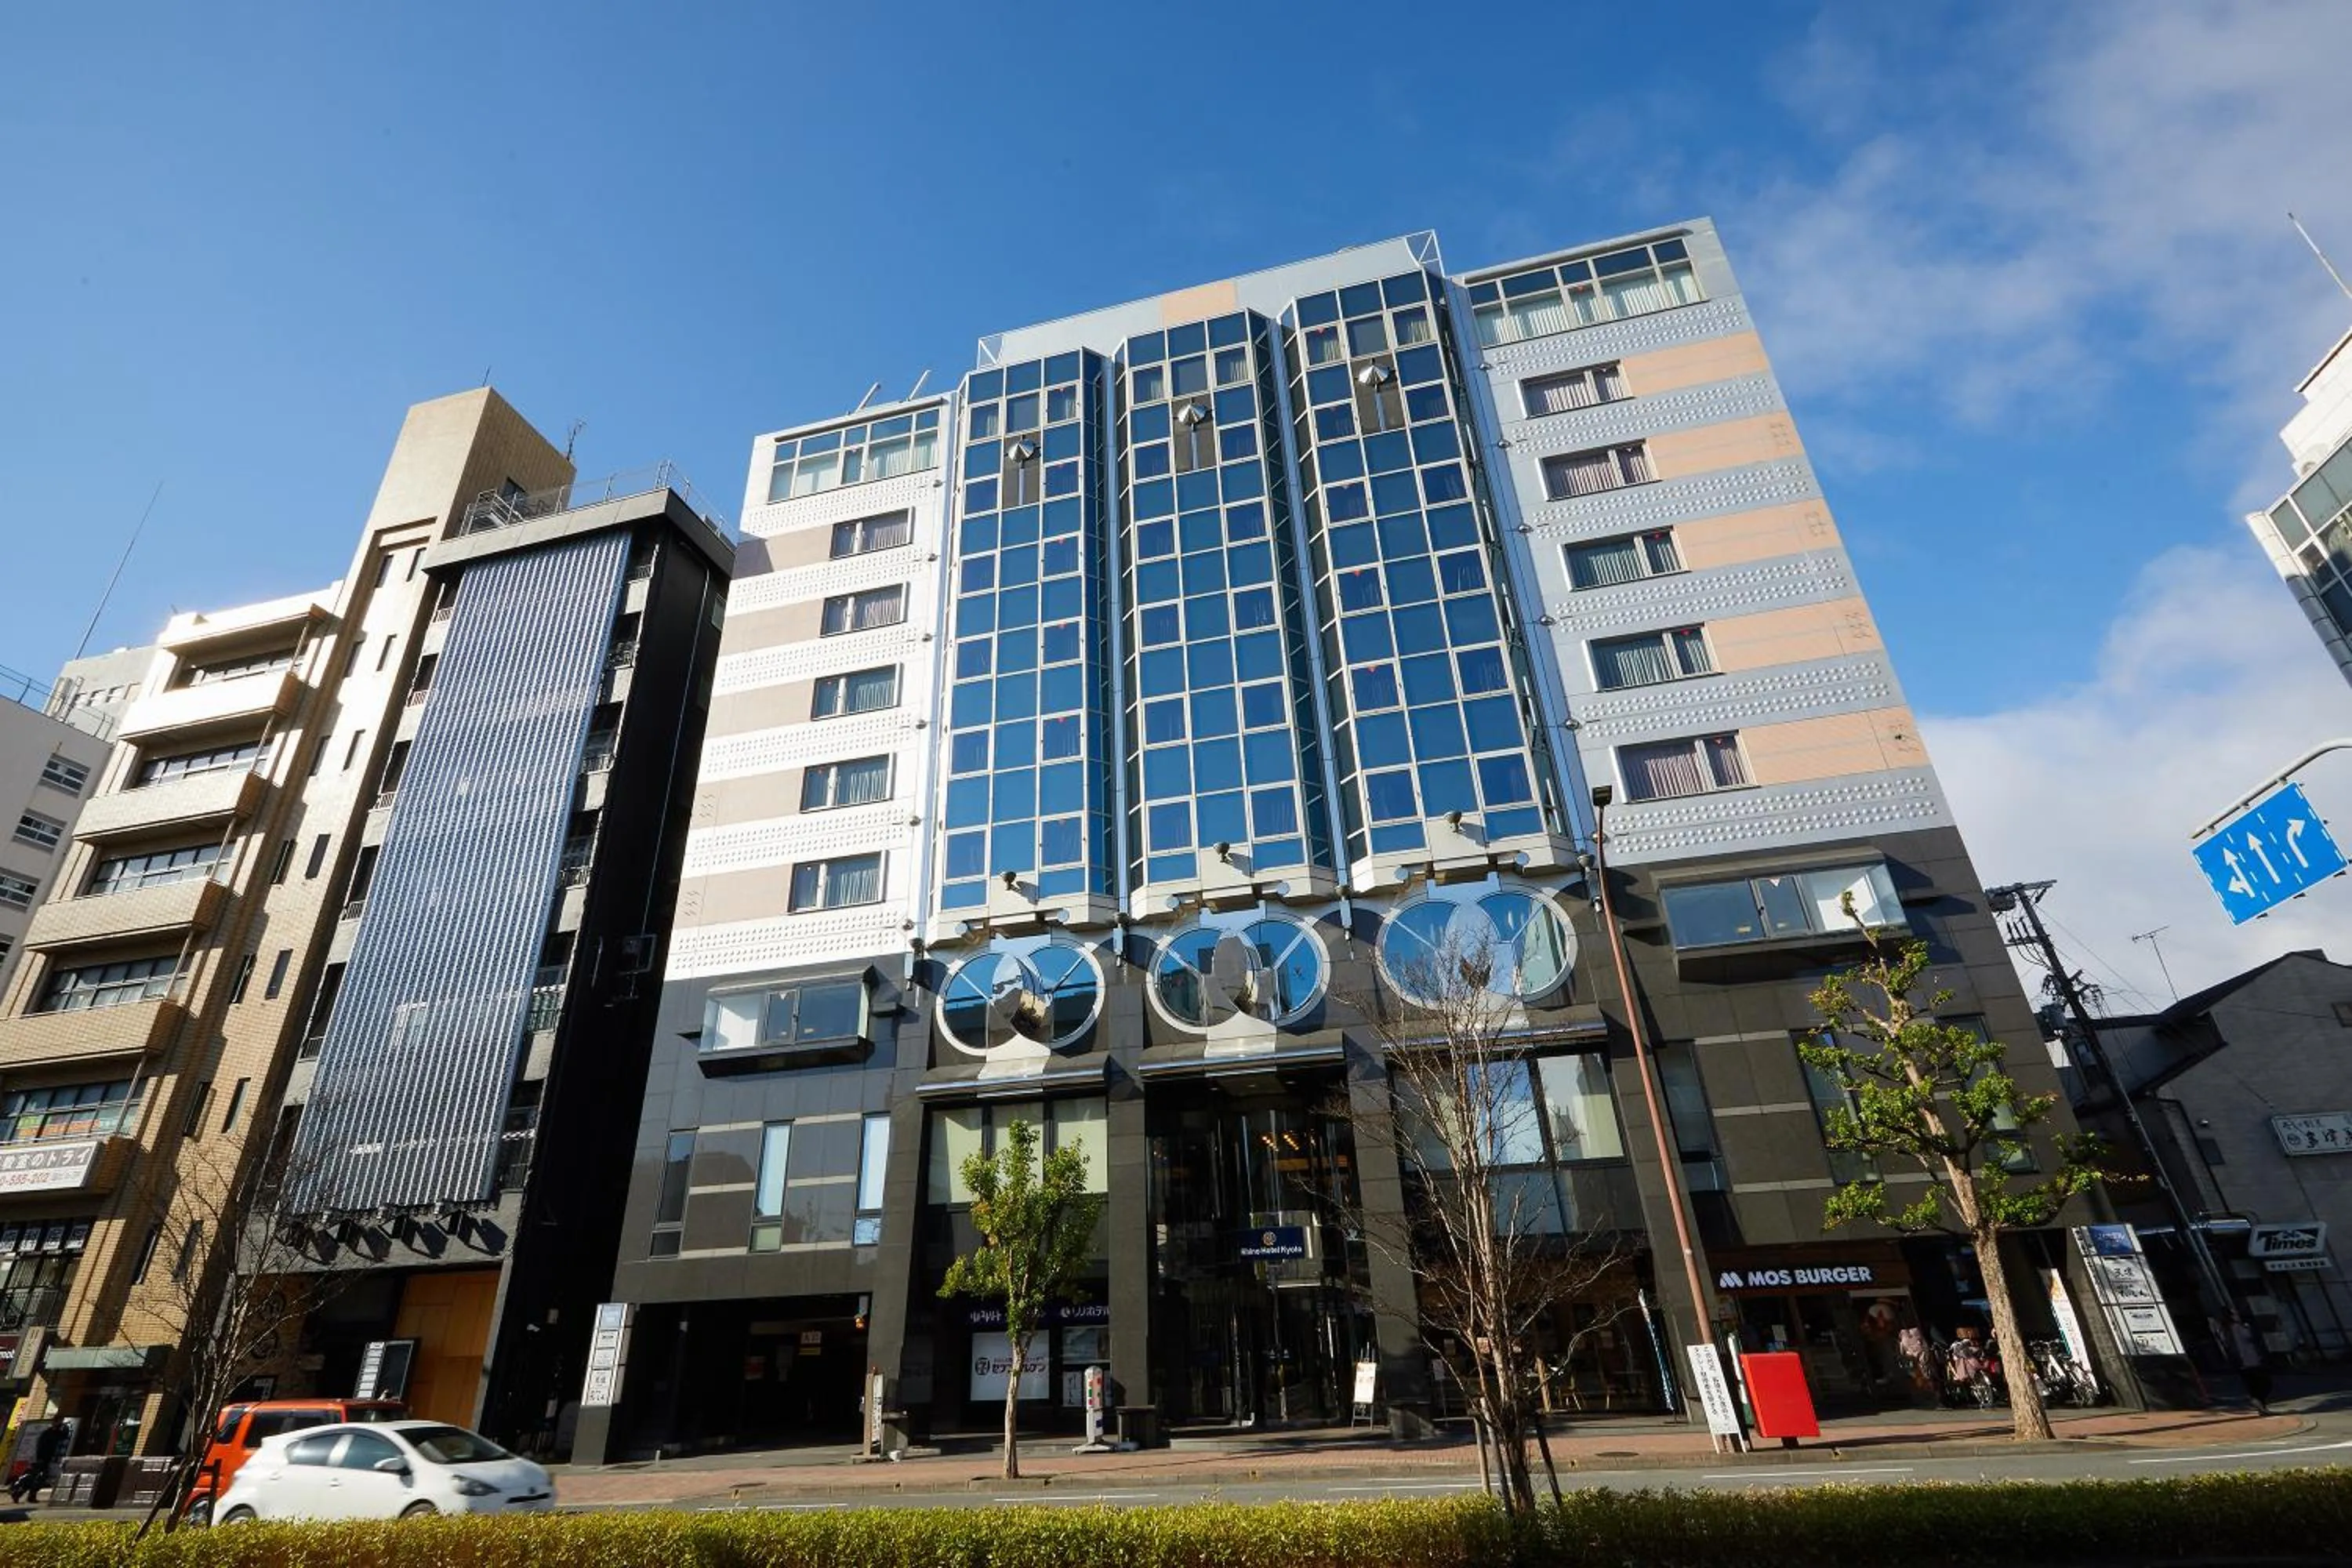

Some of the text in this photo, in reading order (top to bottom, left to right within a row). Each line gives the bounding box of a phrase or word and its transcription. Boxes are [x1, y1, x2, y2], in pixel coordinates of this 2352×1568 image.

[1281, 1245, 1302, 1255] Kyoto
[2263, 1232, 2317, 1252] Times
[1748, 1266, 1873, 1287] MOS BURGER
